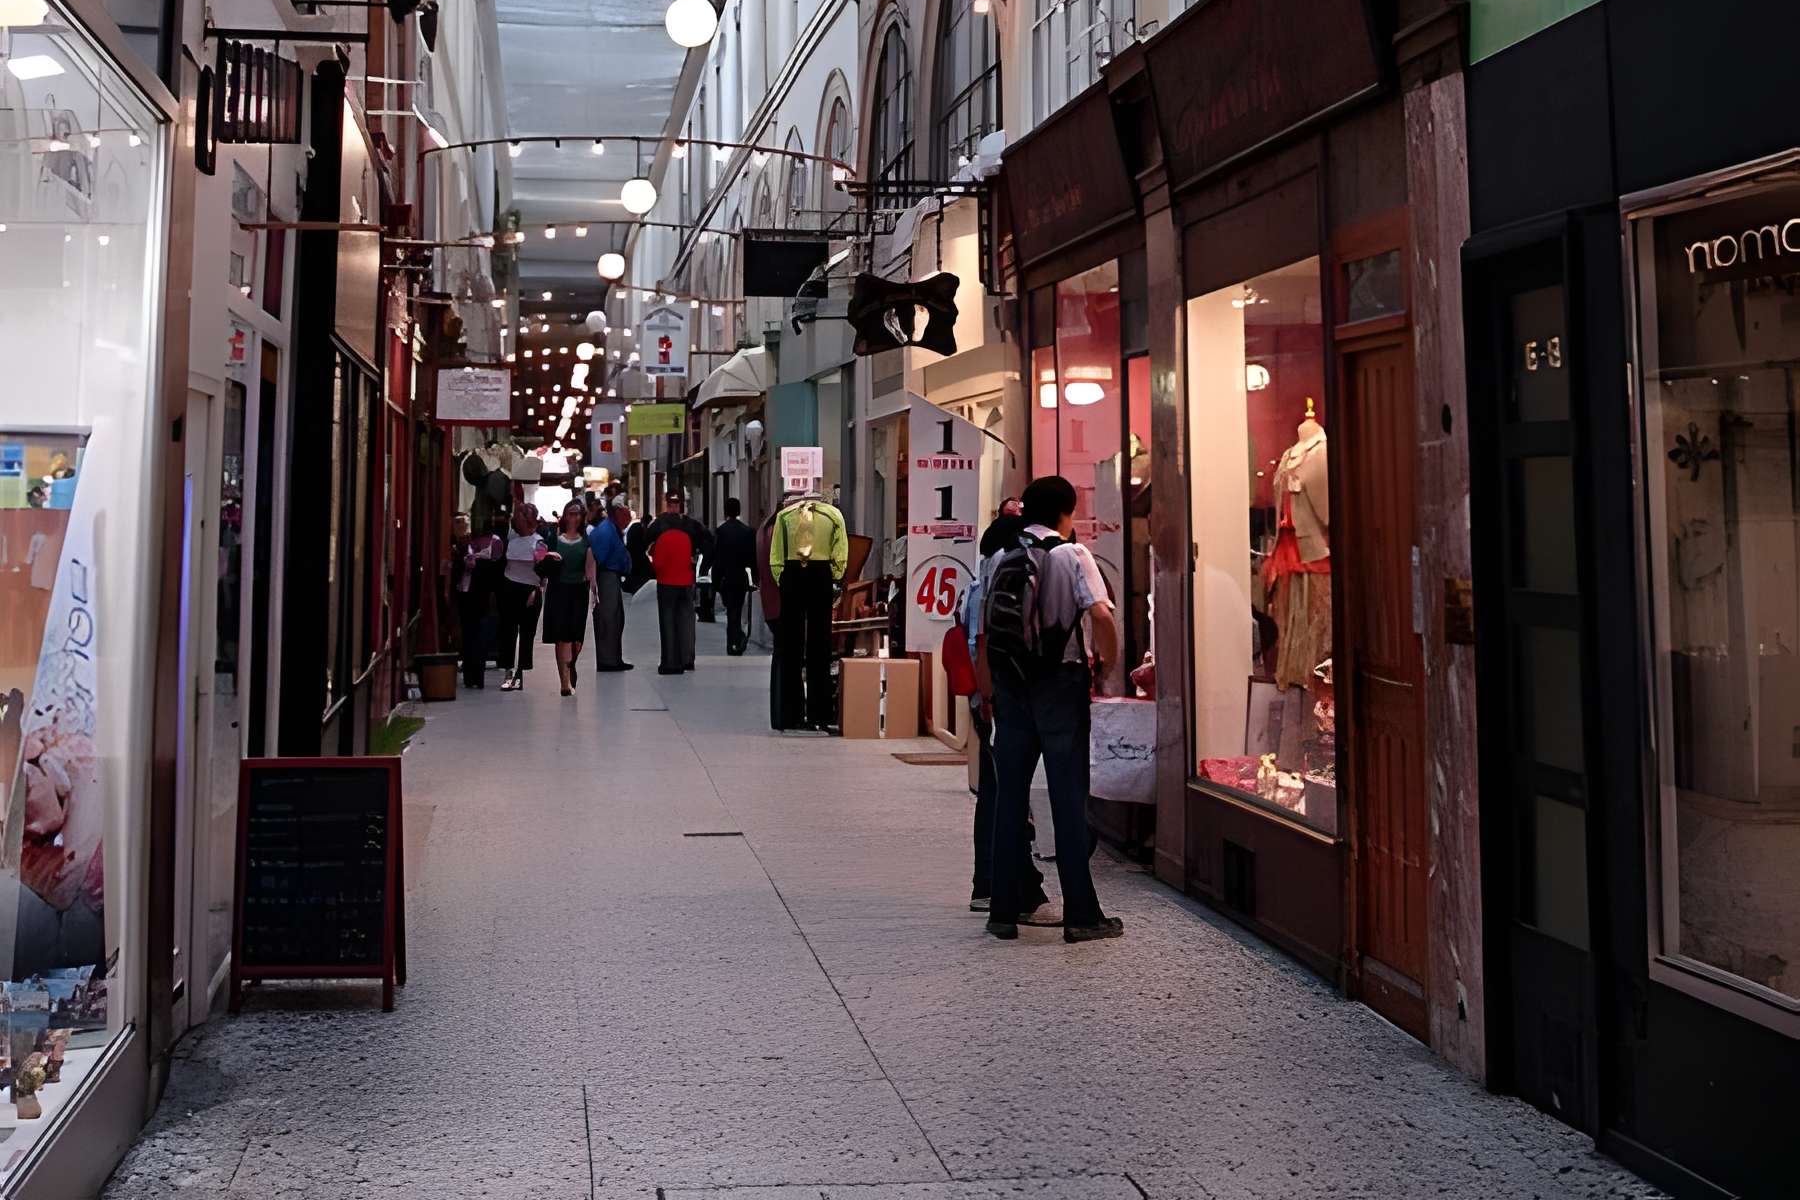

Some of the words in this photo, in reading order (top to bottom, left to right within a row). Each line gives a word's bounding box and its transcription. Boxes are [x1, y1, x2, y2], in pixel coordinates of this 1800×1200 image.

[936, 418, 961, 455] 1
[934, 485, 958, 521] 1
[916, 566, 957, 615] 45
